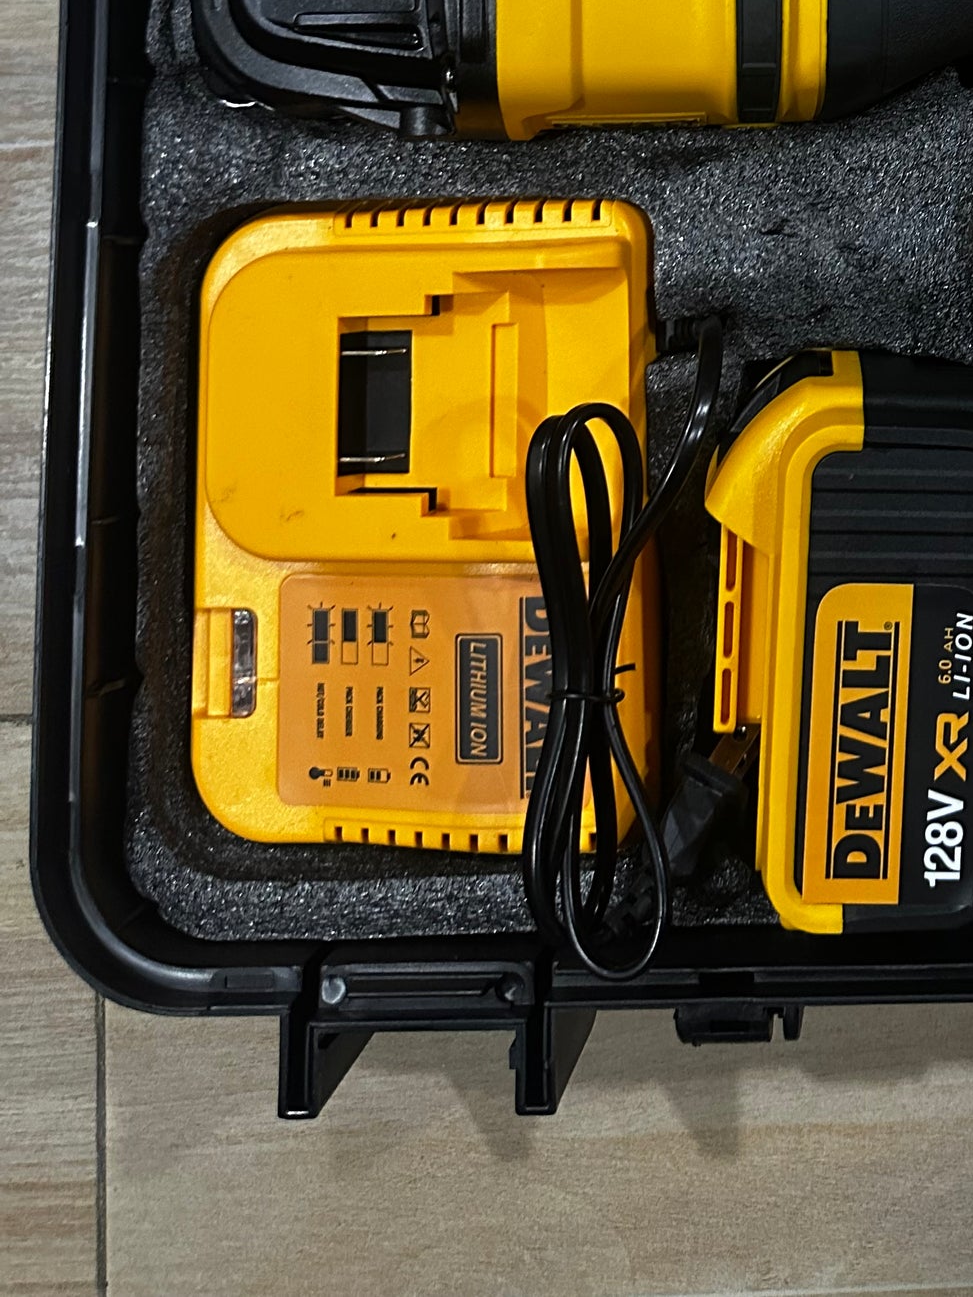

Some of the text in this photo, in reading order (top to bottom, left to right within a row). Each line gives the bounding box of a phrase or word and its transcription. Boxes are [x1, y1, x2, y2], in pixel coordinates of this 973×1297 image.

[469, 642, 488, 757] LITHIUM ION
[938, 627, 953, 684] 6.0 AH
[952, 612, 973, 701] LI-ION
[924, 711, 969, 887] 128V XR
